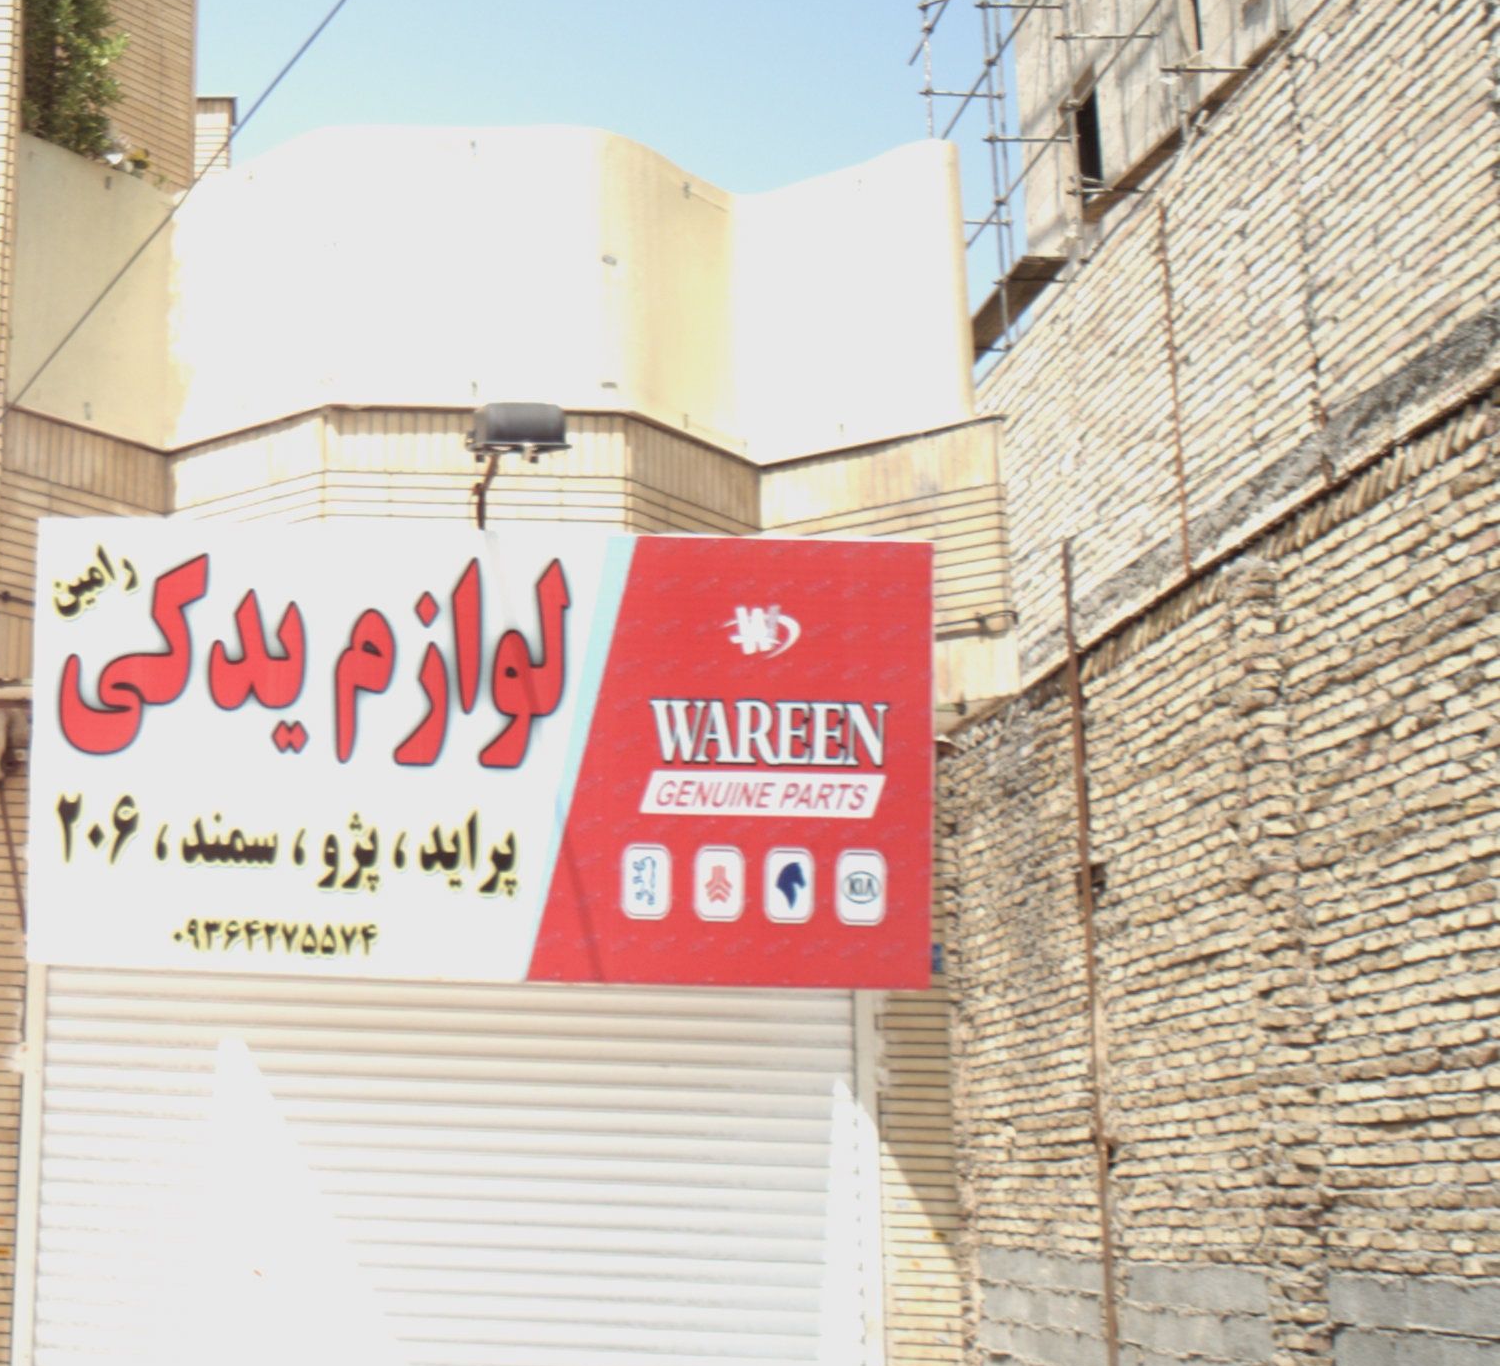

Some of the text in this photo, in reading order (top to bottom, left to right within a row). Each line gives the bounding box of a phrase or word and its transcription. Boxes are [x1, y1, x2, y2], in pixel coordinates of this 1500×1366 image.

[53, 544, 139, 619] رامین
[58, 552, 571, 768] لوازم یدکی
[649, 698, 890, 767] WAREEN
[57, 793, 140, 865] ۲۰۶
[655, 780, 869, 811] GENUINE PARTS
[172, 918, 378, 956] ۰۹۳۶۴۲۷۵۵۷۴
